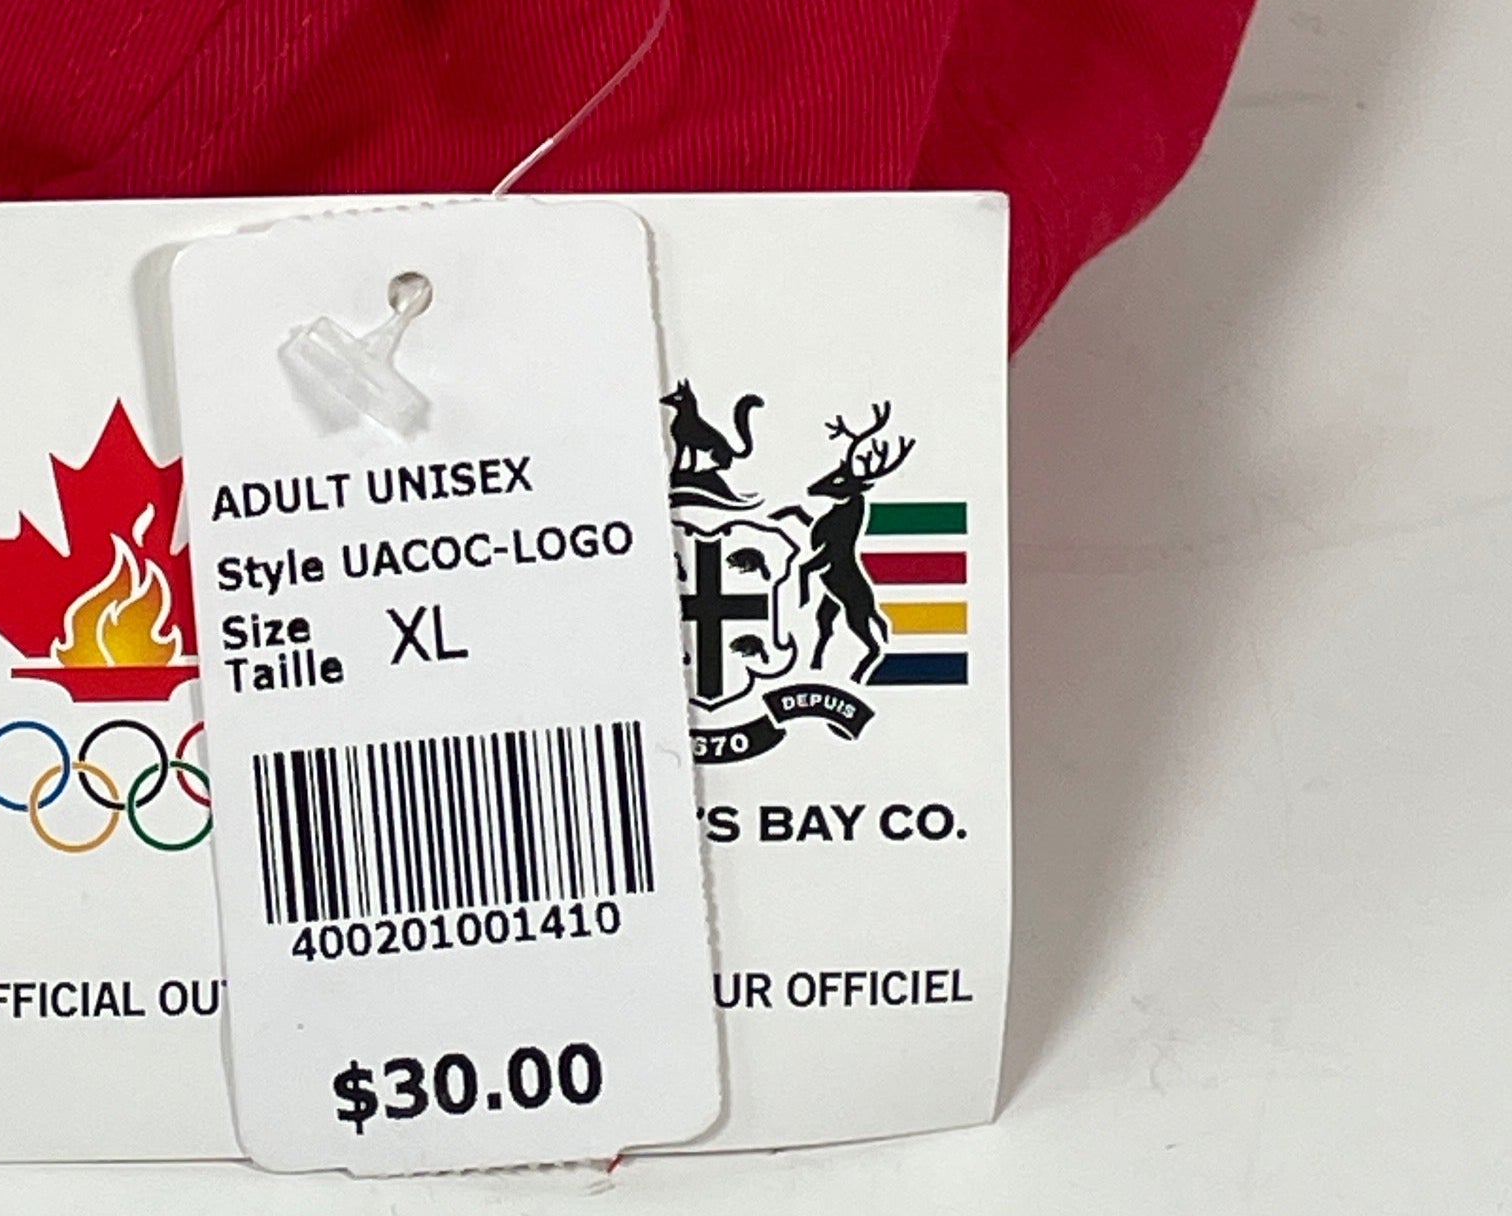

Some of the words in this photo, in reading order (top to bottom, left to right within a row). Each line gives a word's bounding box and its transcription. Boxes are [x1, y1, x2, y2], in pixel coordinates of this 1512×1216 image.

[212, 472, 350, 521] ADULT
[367, 456, 532, 503] UNISEX
[217, 548, 325, 595] Style
[343, 520, 633, 578] UACOC-LOGO
[222, 613, 311, 650] Size
[386, 604, 469, 665] XL
[224, 649, 344, 693] Taille
[781, 692, 856, 719] DEPUIS
[759, 804, 866, 842] BAY
[879, 803, 968, 841] CO.
[291, 900, 622, 962] 400201001410
[158, 978, 228, 1017] OU
[712, 971, 773, 1009] UR
[787, 968, 974, 1008] OFFICIEL
[333, 1042, 603, 1135] $30.00
